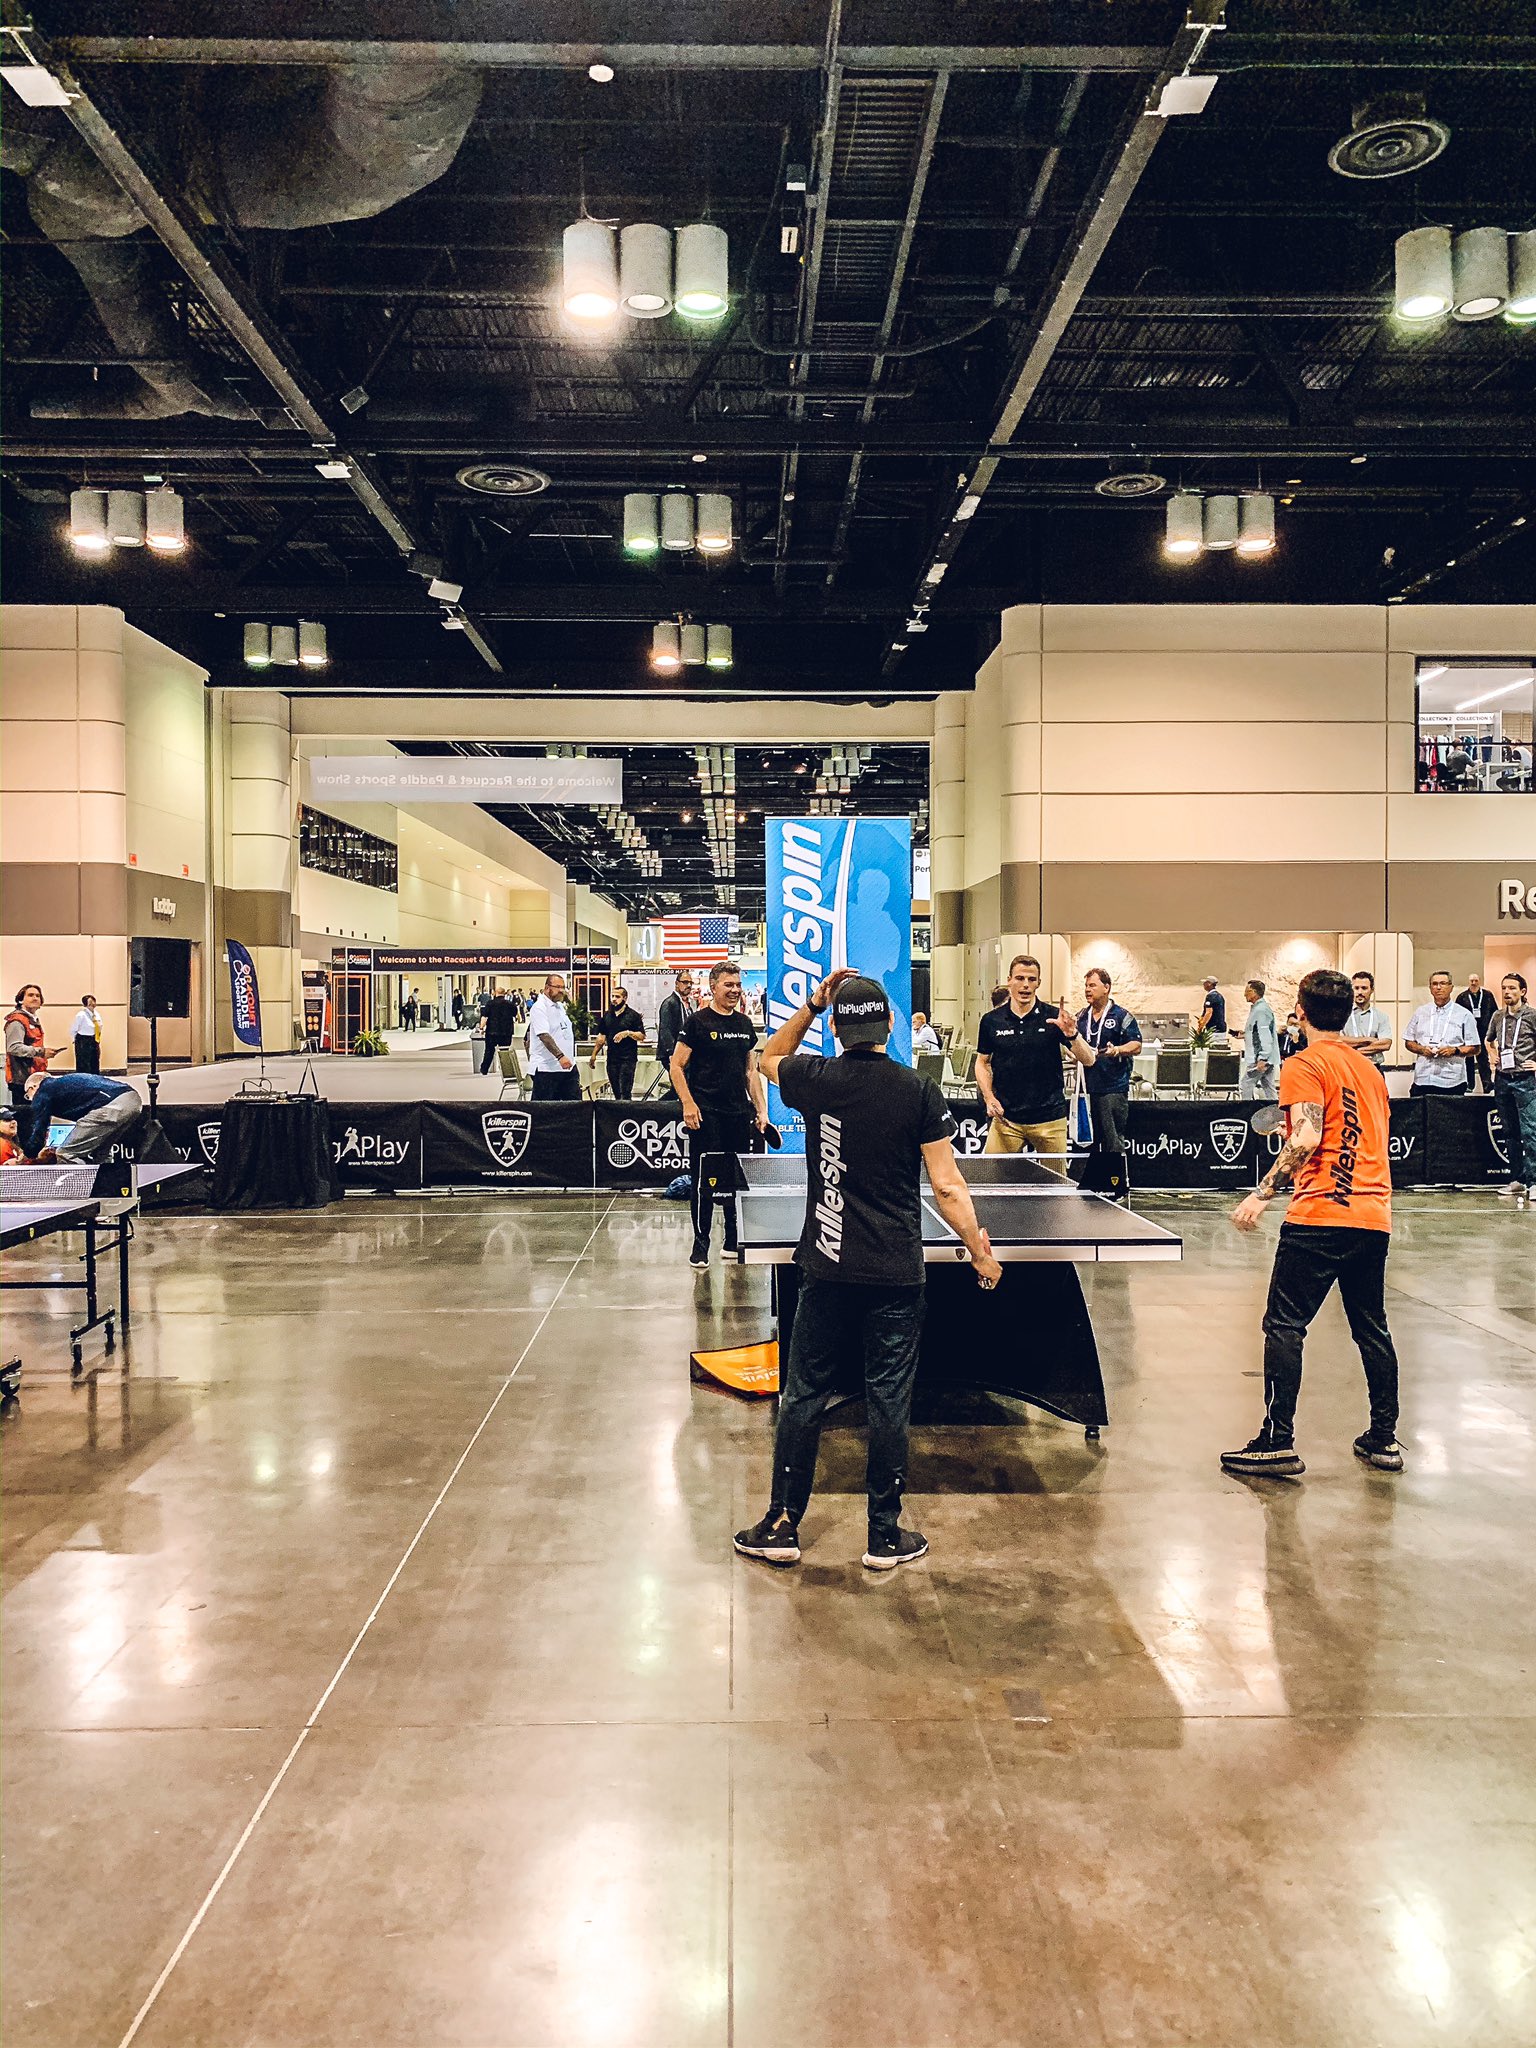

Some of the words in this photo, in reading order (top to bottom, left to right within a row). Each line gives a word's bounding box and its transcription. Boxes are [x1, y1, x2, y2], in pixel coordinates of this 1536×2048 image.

[153, 897, 176, 918] Lobby
[378, 956, 417, 964] Welcome
[418, 956, 427, 964] to
[428, 956, 442, 964] the
[444, 956, 477, 965] Racquet
[516, 956, 542, 964] Sports
[239, 977, 250, 1029] PADDLE
[838, 1001, 884, 1016] UnPlugNPlay
[487, 1117, 527, 1129] killerspin
